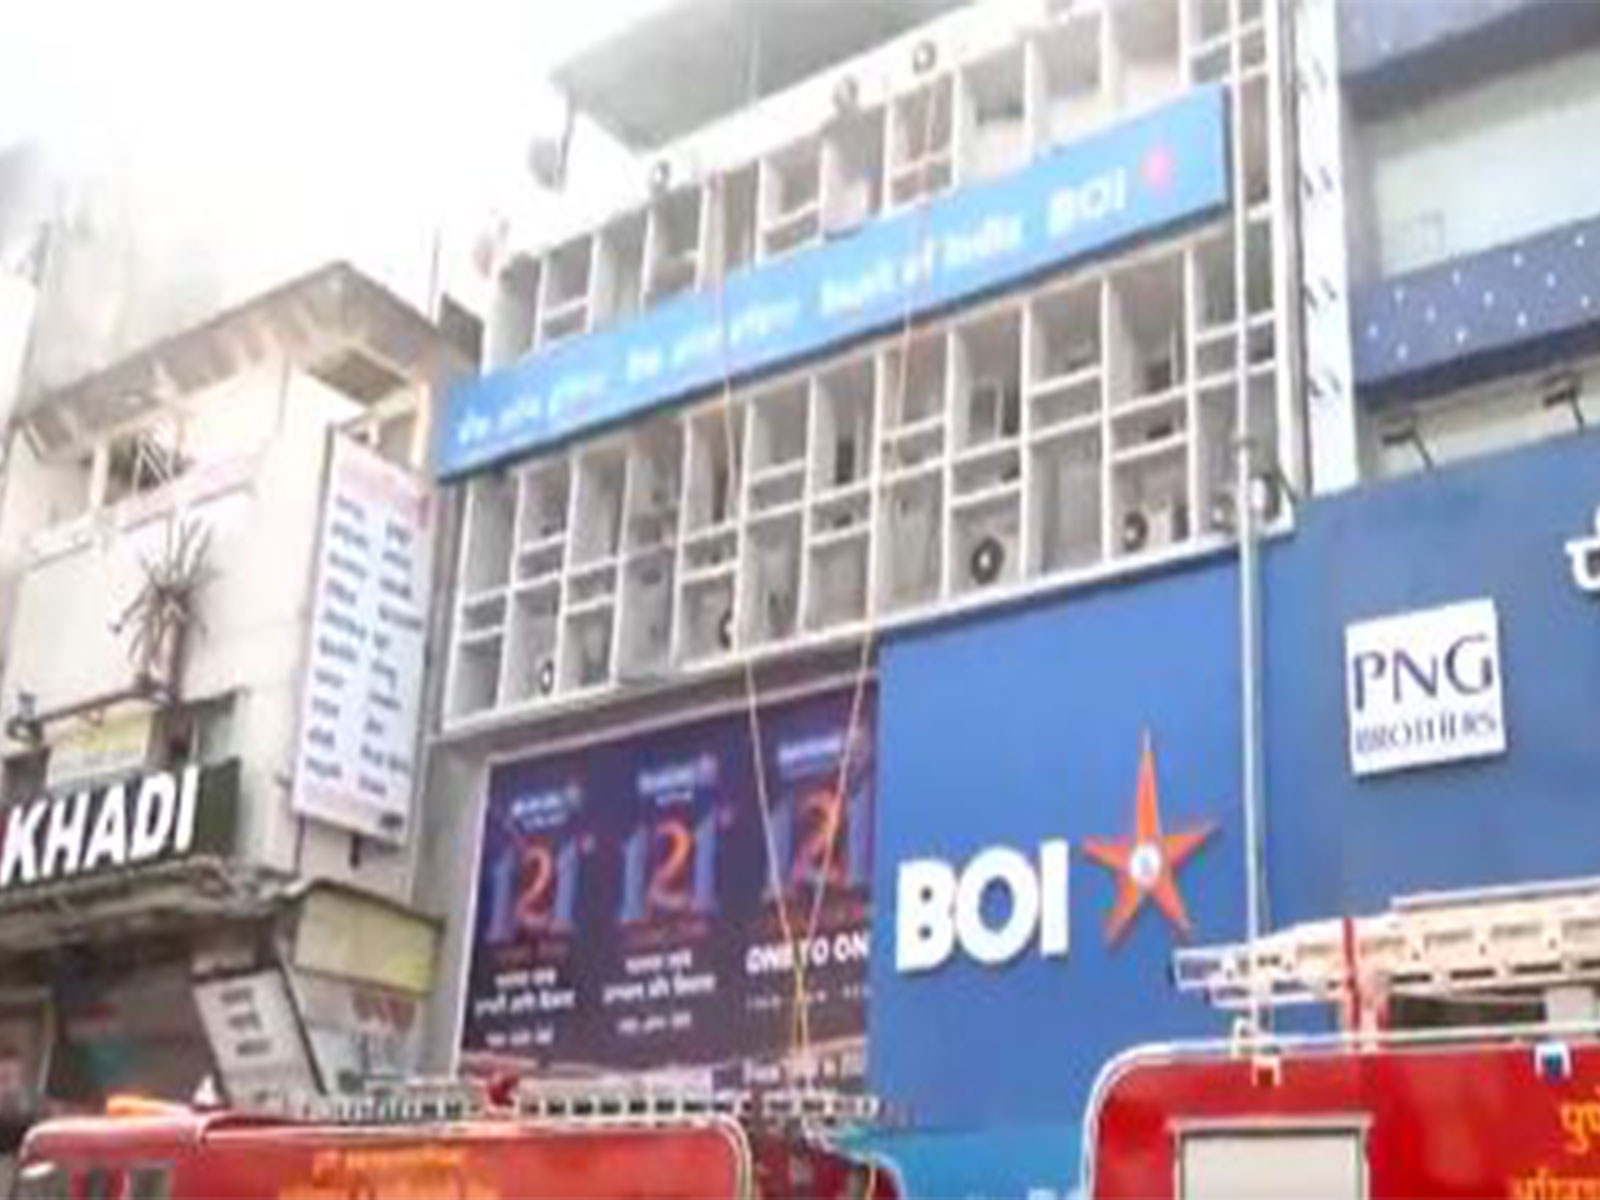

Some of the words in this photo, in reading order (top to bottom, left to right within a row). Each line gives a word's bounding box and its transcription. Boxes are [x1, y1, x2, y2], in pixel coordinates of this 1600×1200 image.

[1354, 631, 1494, 711] PNG
[0, 763, 200, 888] KHADI
[896, 838, 1069, 972] BOI
